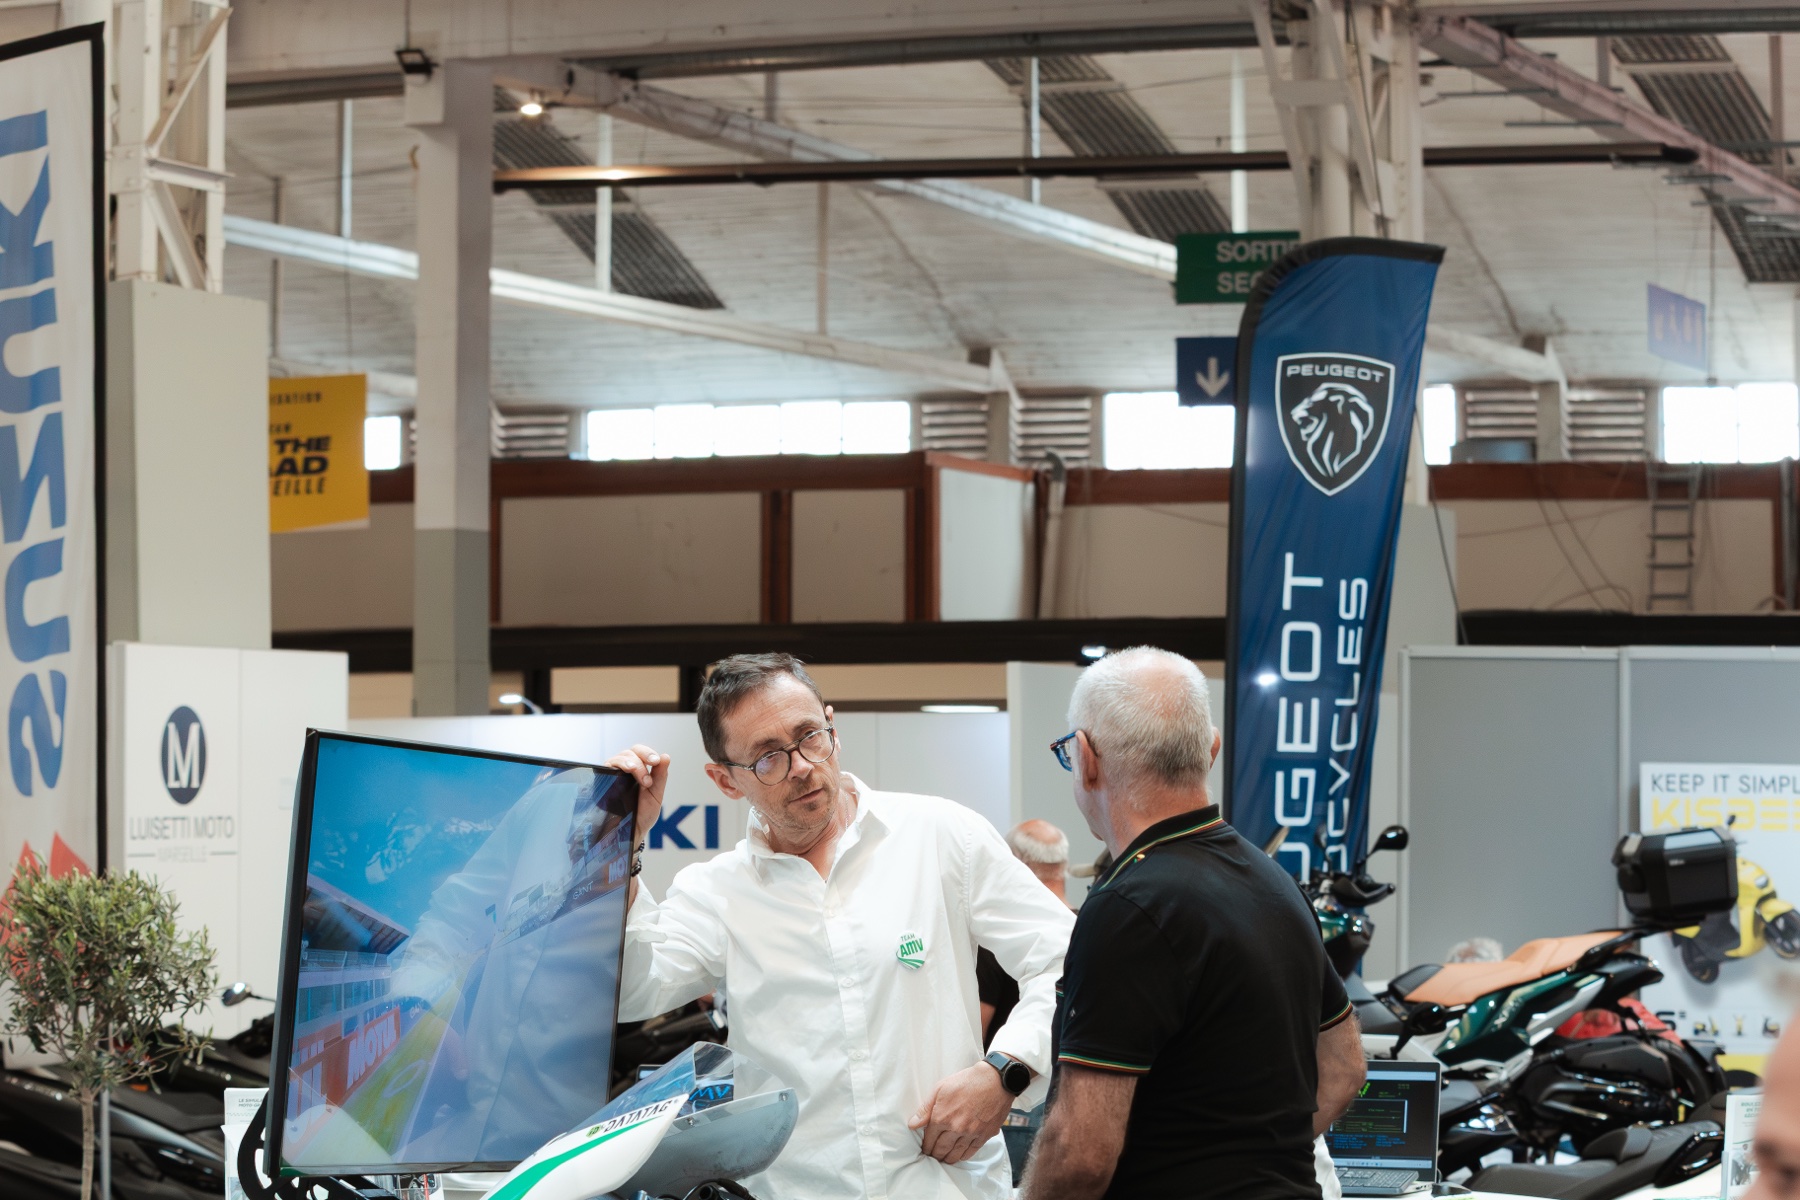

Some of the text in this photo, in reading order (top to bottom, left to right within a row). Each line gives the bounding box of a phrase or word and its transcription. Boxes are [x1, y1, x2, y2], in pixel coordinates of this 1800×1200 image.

[1216, 239, 1298, 263] SORTI
[1286, 363, 1385, 383] PEUGEOT
[274, 434, 331, 454] THE
[270, 455, 329, 477] AD
[1651, 773, 1705, 793] KEEP
[1714, 774, 1730, 793] IT
[129, 816, 235, 840] LUISETTI MOTO
[648, 805, 719, 849] KI
[608, 853, 629, 885] MO
[900, 933, 916, 942] TEAM
[900, 938, 924, 958] AMV
[603, 1101, 672, 1133] DATATAG
